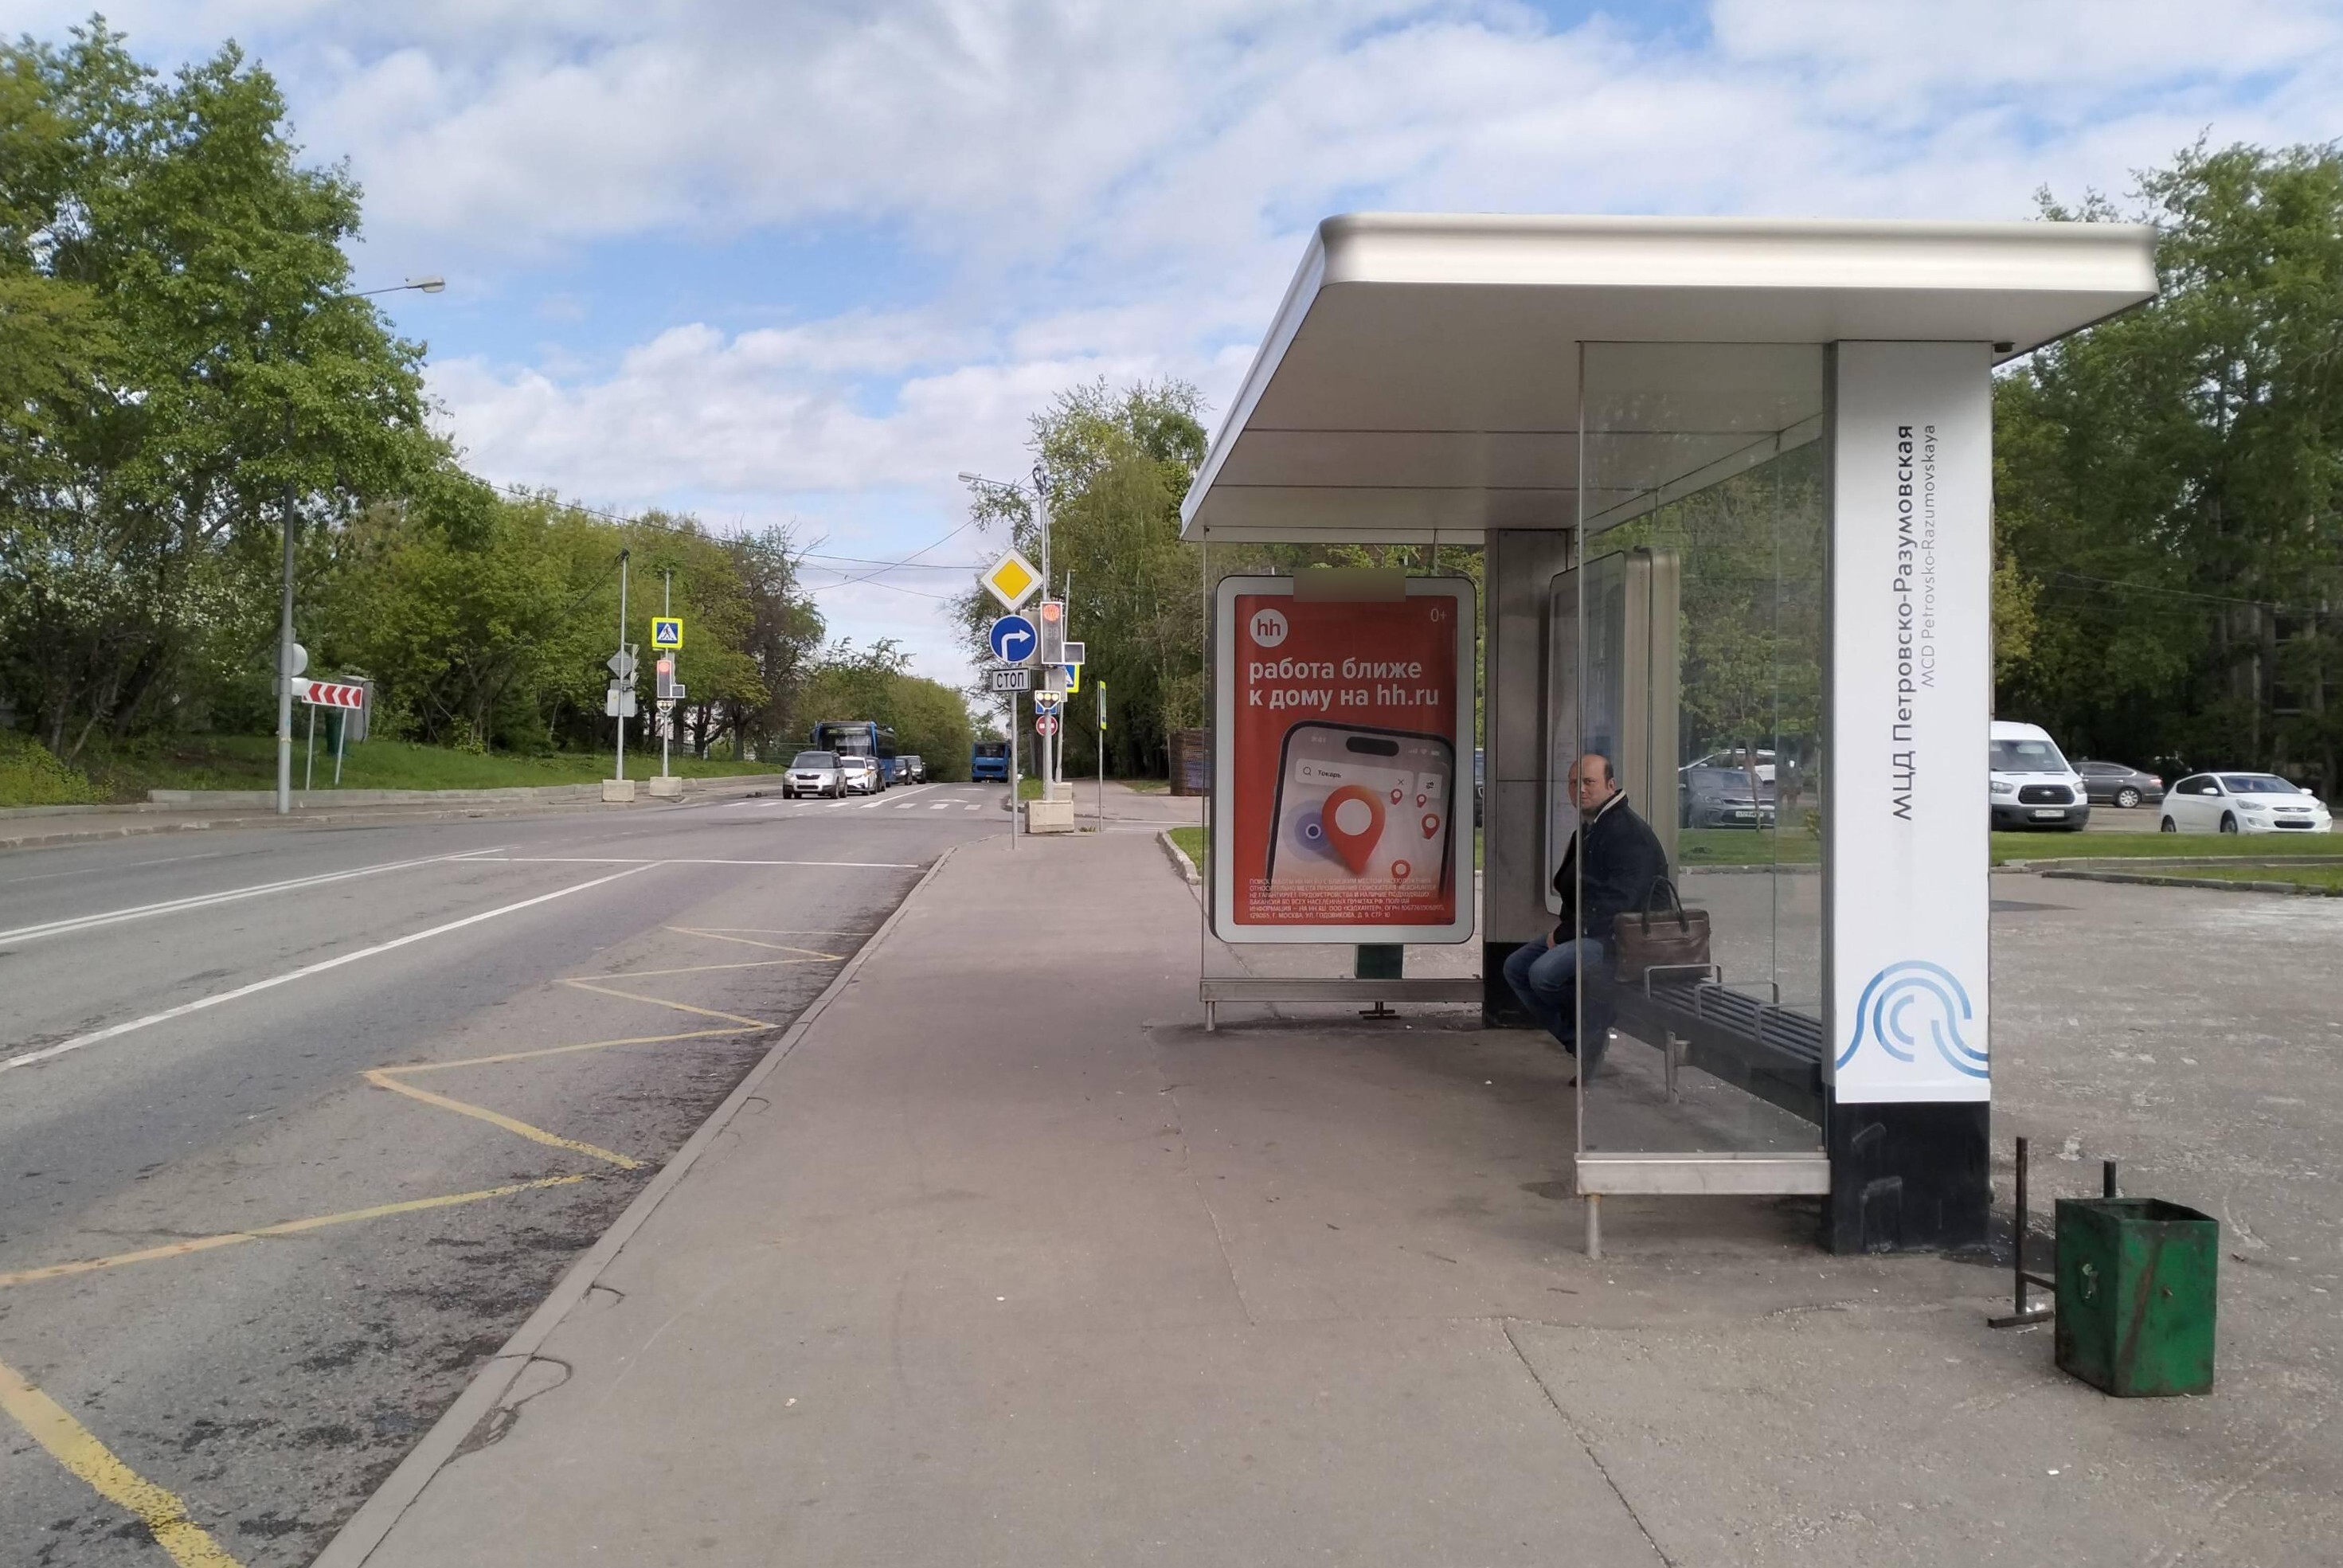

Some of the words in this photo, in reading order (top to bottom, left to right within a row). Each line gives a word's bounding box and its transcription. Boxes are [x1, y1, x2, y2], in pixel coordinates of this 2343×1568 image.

[1921, 424, 1937, 639] Petrovsko-Razumovskaya
[1892, 424, 1917, 741] Петровско-Разумовская
[1257, 618, 1281, 636] hh
[997, 672, 1024, 688] СТОП
[1249, 657, 1335, 684] работа
[1342, 657, 1422, 678] ближе
[1921, 644, 1935, 688] MCD
[1249, 690, 1263, 706] к
[1269, 690, 1333, 712] дому
[1340, 690, 1368, 706] на
[1377, 683, 1439, 706] hh.ru
[1317, 769, 1342, 779] Токарь
[1892, 750, 1917, 821] МЦД
